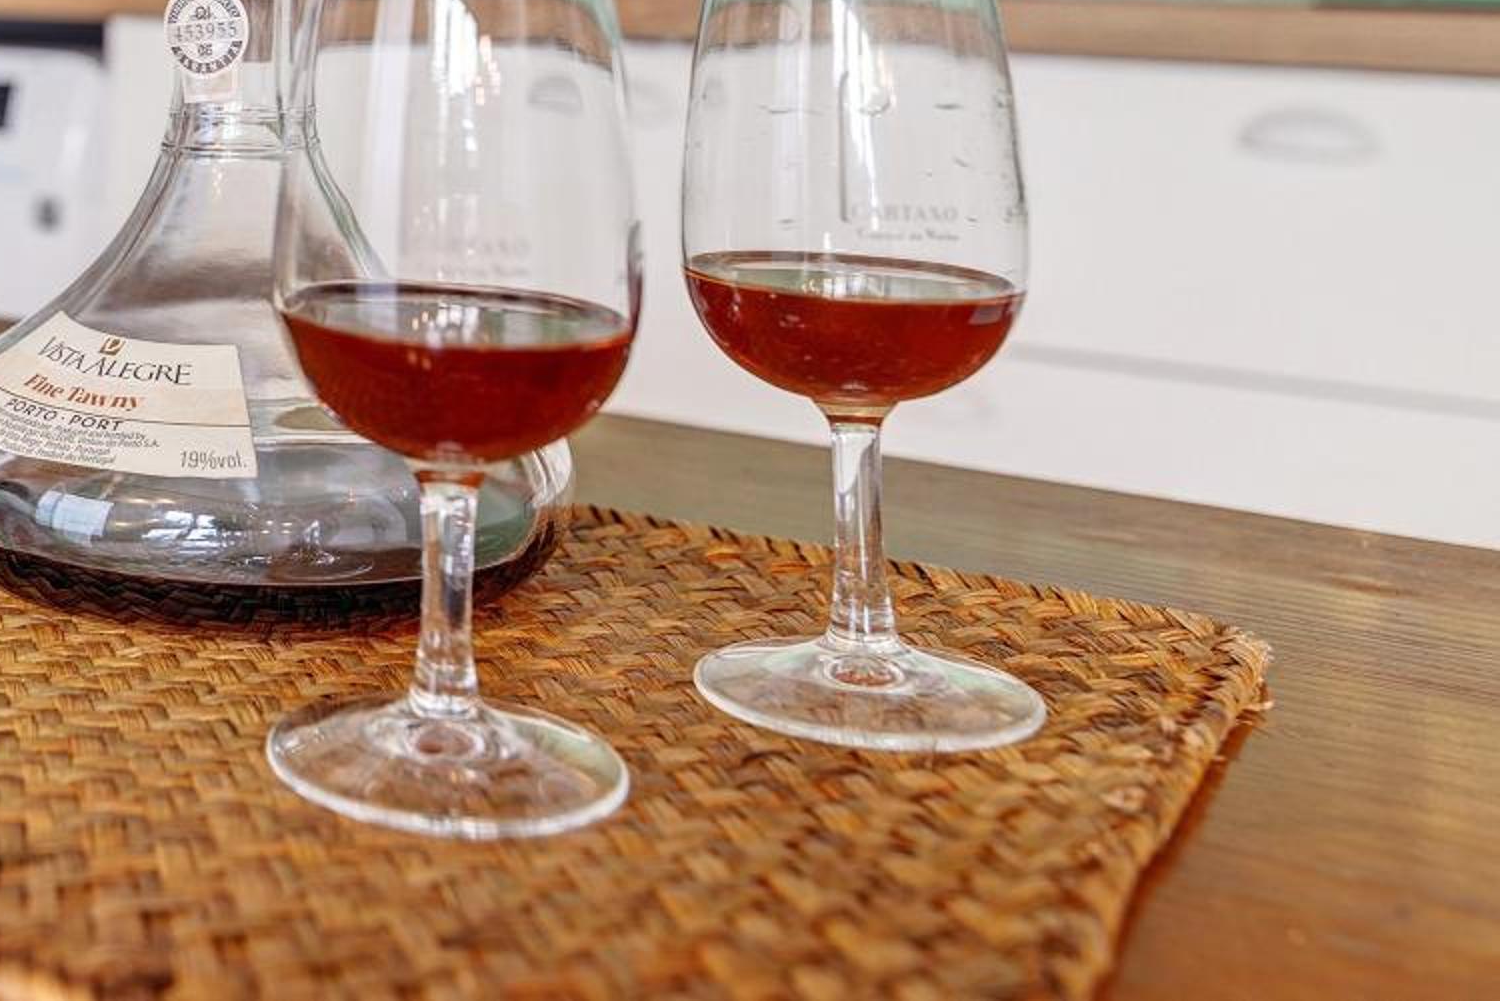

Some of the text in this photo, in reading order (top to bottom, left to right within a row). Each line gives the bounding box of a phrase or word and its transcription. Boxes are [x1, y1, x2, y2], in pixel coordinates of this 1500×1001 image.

[38, 336, 193, 386] VISTA ALEGRE
[24, 373, 140, 412] Fine Tawny
[5, 398, 57, 422] PORTO
[70, 414, 123, 431] PORT
